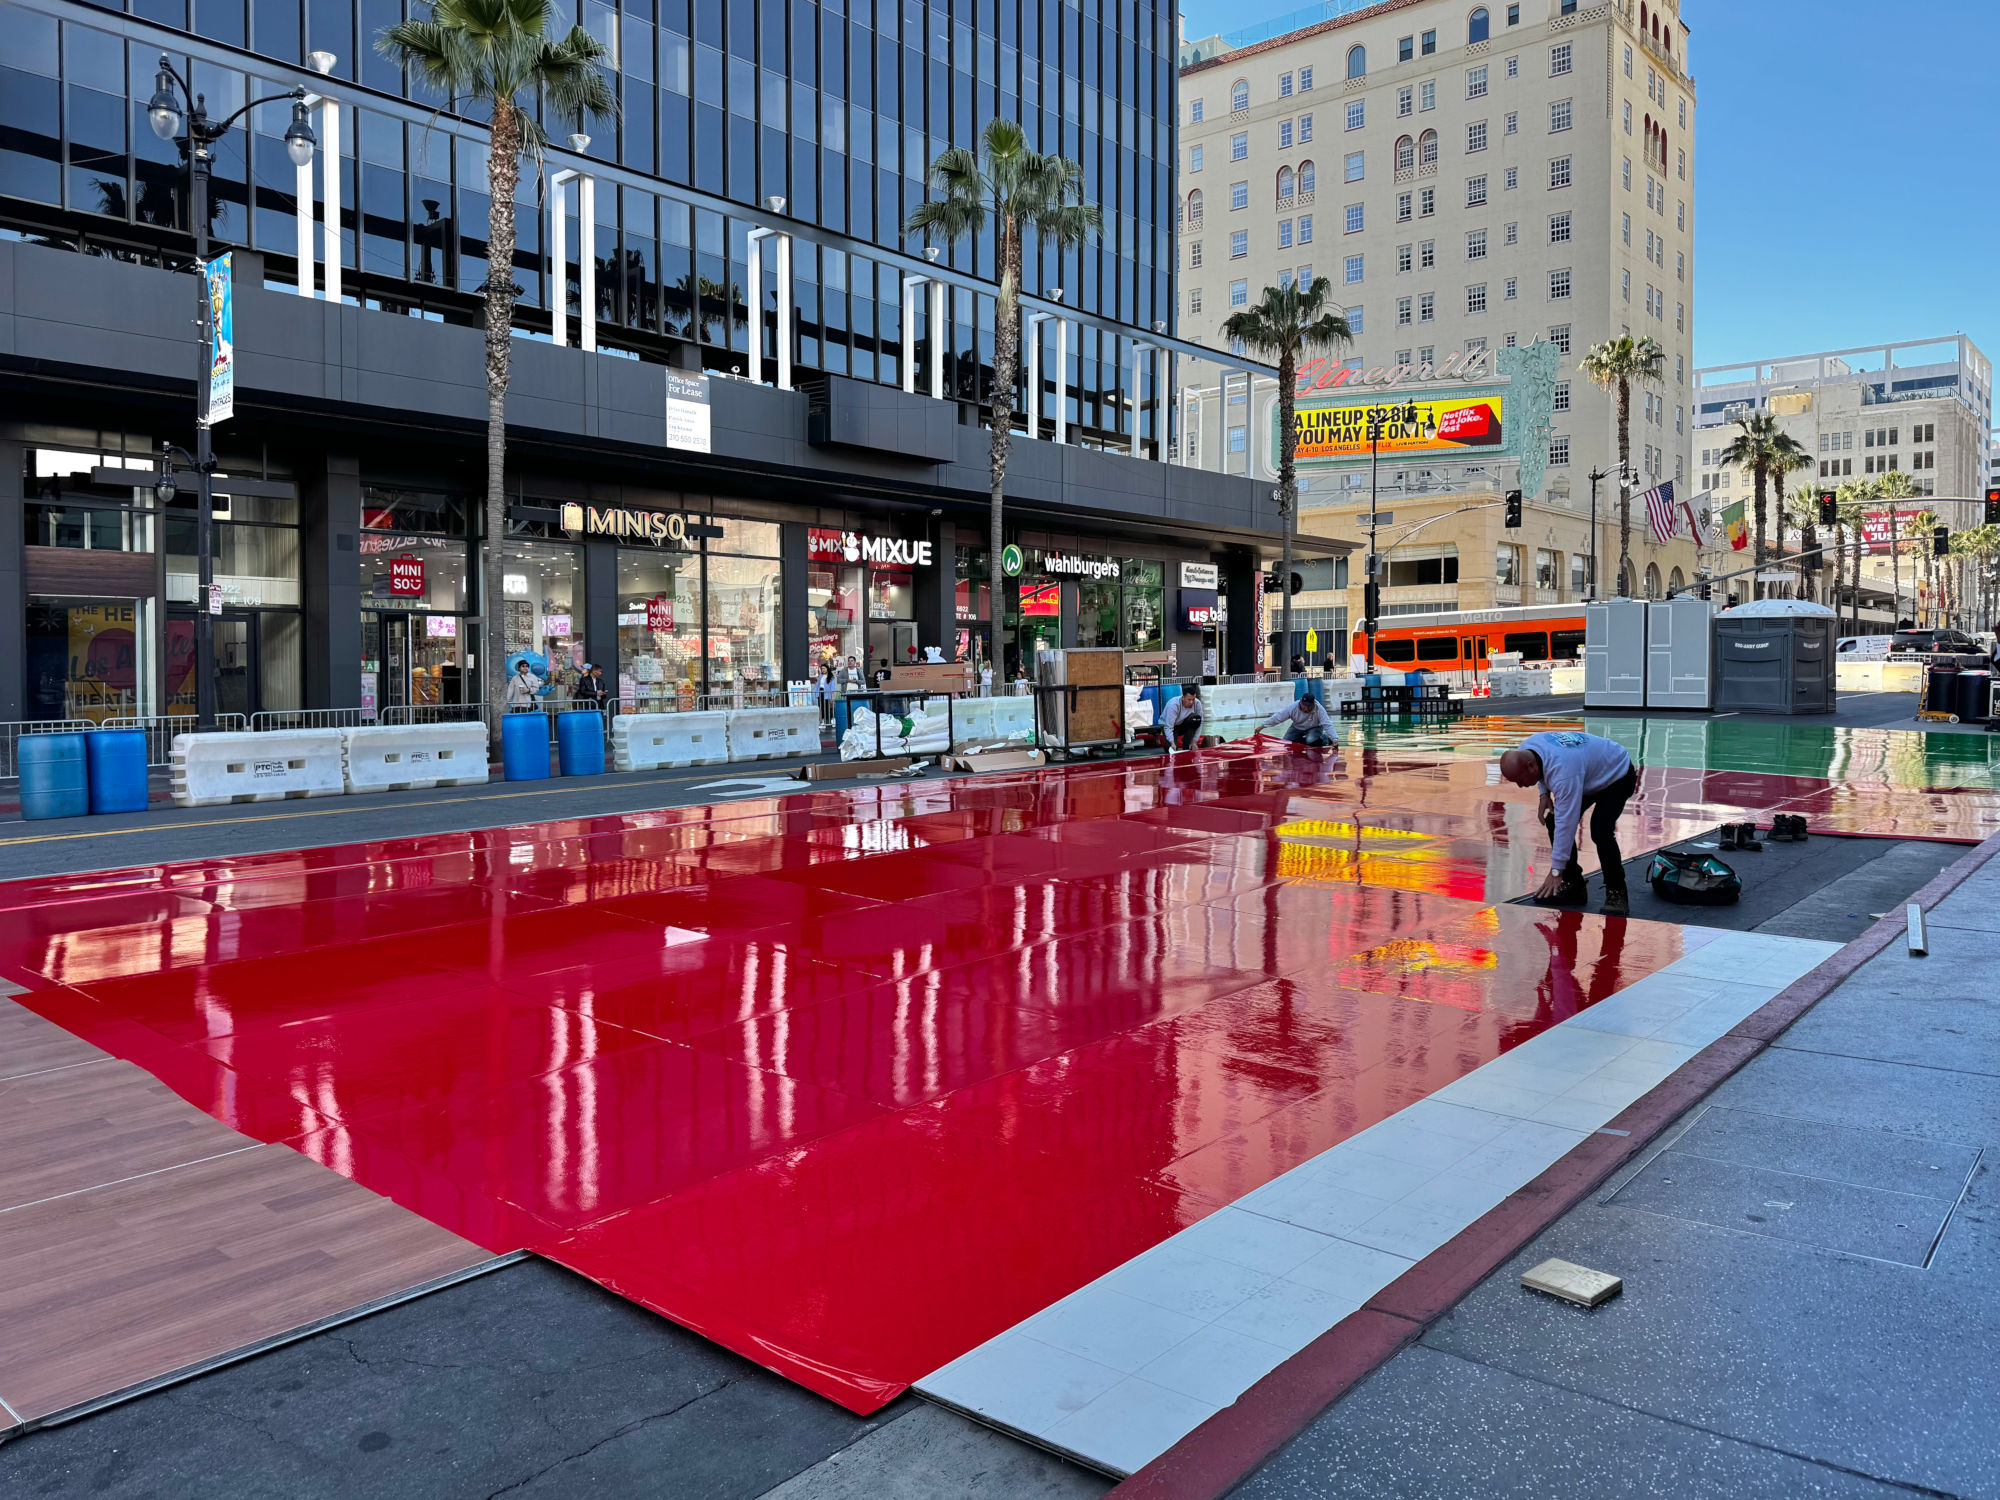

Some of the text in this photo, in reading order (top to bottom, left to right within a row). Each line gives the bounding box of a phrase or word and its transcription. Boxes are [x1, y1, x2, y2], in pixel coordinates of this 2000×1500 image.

[668, 376, 700, 387] Office Space
[668, 384, 702, 398] For Lease
[1294, 414, 1304, 428] A
[1307, 410, 1364, 428] LINEUP
[1442, 408, 1475, 420] Netflix
[1294, 428, 1327, 445] YOU
[1328, 425, 1363, 443] MAY
[1366, 424, 1384, 441] BE
[1439, 424, 1460, 434] Fest
[1294, 446, 1304, 454] AY
[1334, 444, 1360, 452] ANGELES
[587, 506, 685, 540] MINISO
[1865, 524, 1884, 532] WE
[862, 536, 932, 565] MIXUE
[393, 564, 421, 576] MINI
[1044, 555, 1120, 579] wahlburgers
[222, 585, 240, 593] 922
[244, 596, 261, 605] 109
[650, 605, 672, 615] MINI
[1460, 612, 1503, 624] Metro
